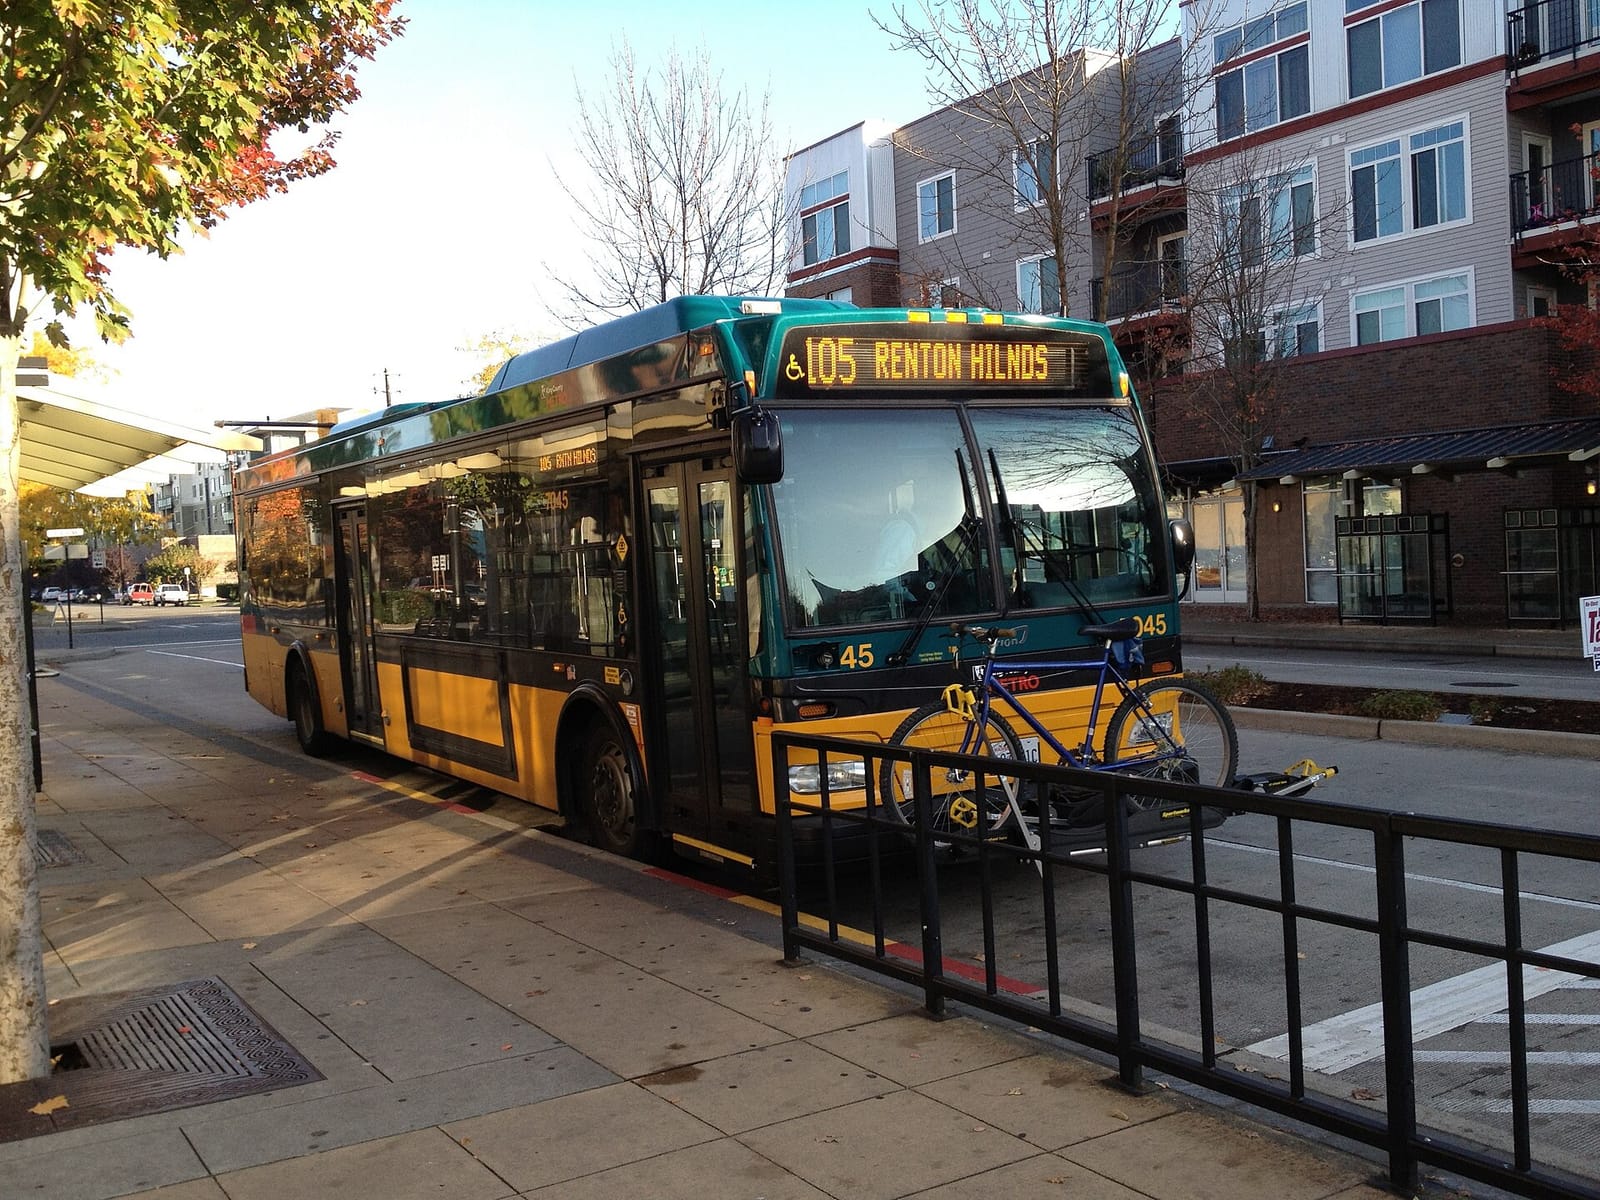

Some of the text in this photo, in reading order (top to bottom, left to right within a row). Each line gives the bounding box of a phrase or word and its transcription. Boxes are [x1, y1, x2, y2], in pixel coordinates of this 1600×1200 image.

[806, 337, 1048, 384] 105 RENTON HILNDS
[540, 455, 552, 471] 105
[840, 643, 874, 669] 45
